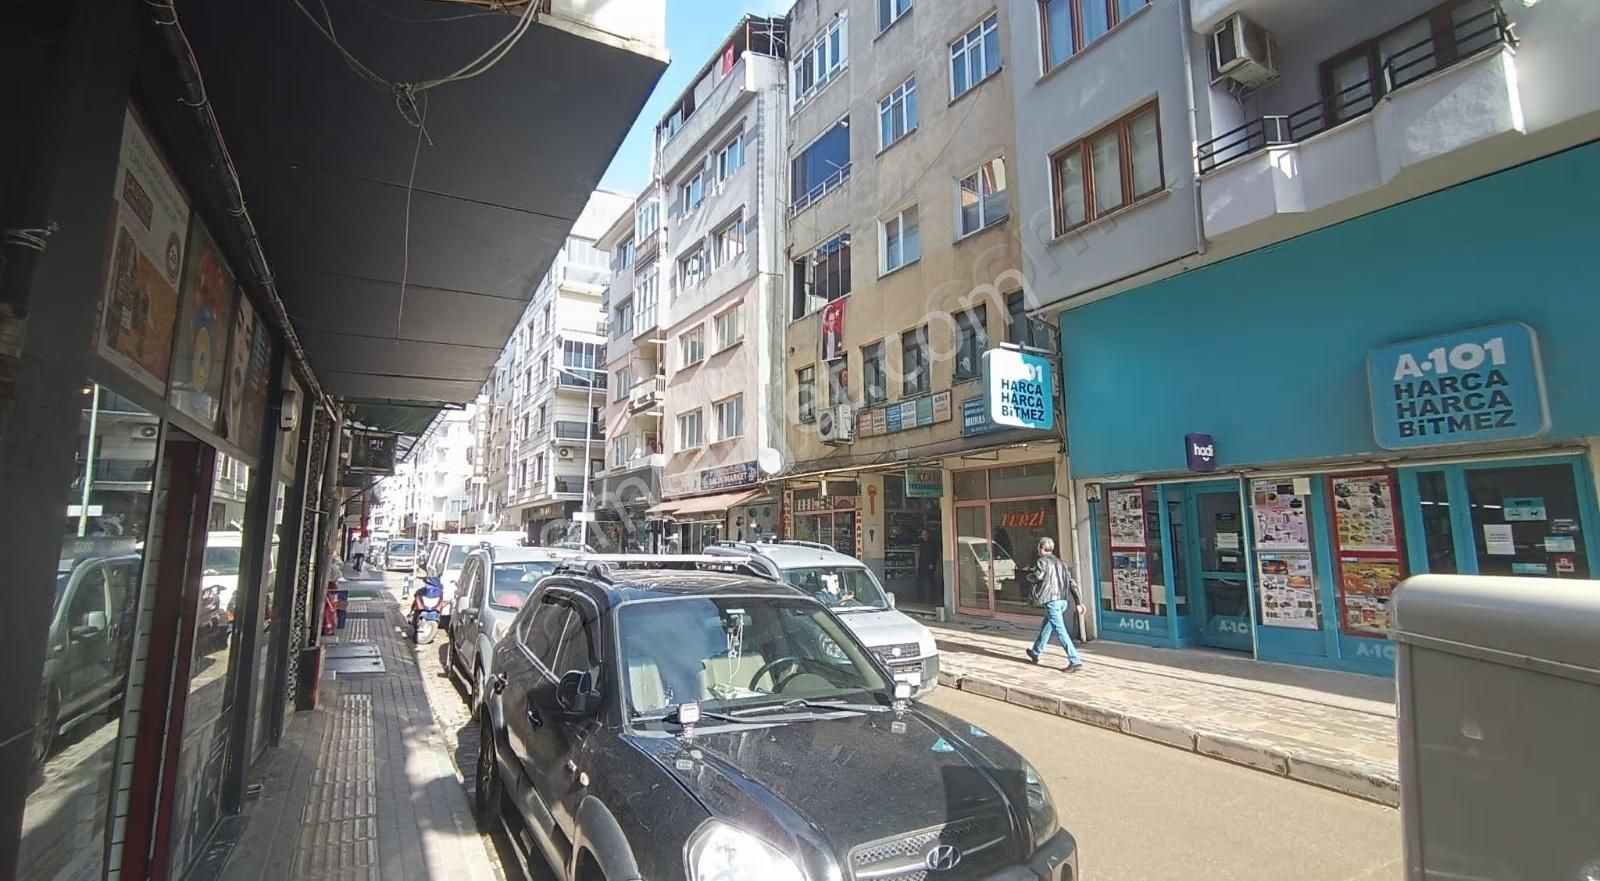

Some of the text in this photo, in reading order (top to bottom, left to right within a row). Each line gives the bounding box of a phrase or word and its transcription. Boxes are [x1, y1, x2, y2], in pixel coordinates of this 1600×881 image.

[1001, 379, 1043, 396] HARCA
[1394, 369, 1509, 400] HARCA
[1001, 392, 1044, 409] HARCA
[1396, 390, 1512, 419] HARCA
[1193, 443, 1214, 457] hadi
